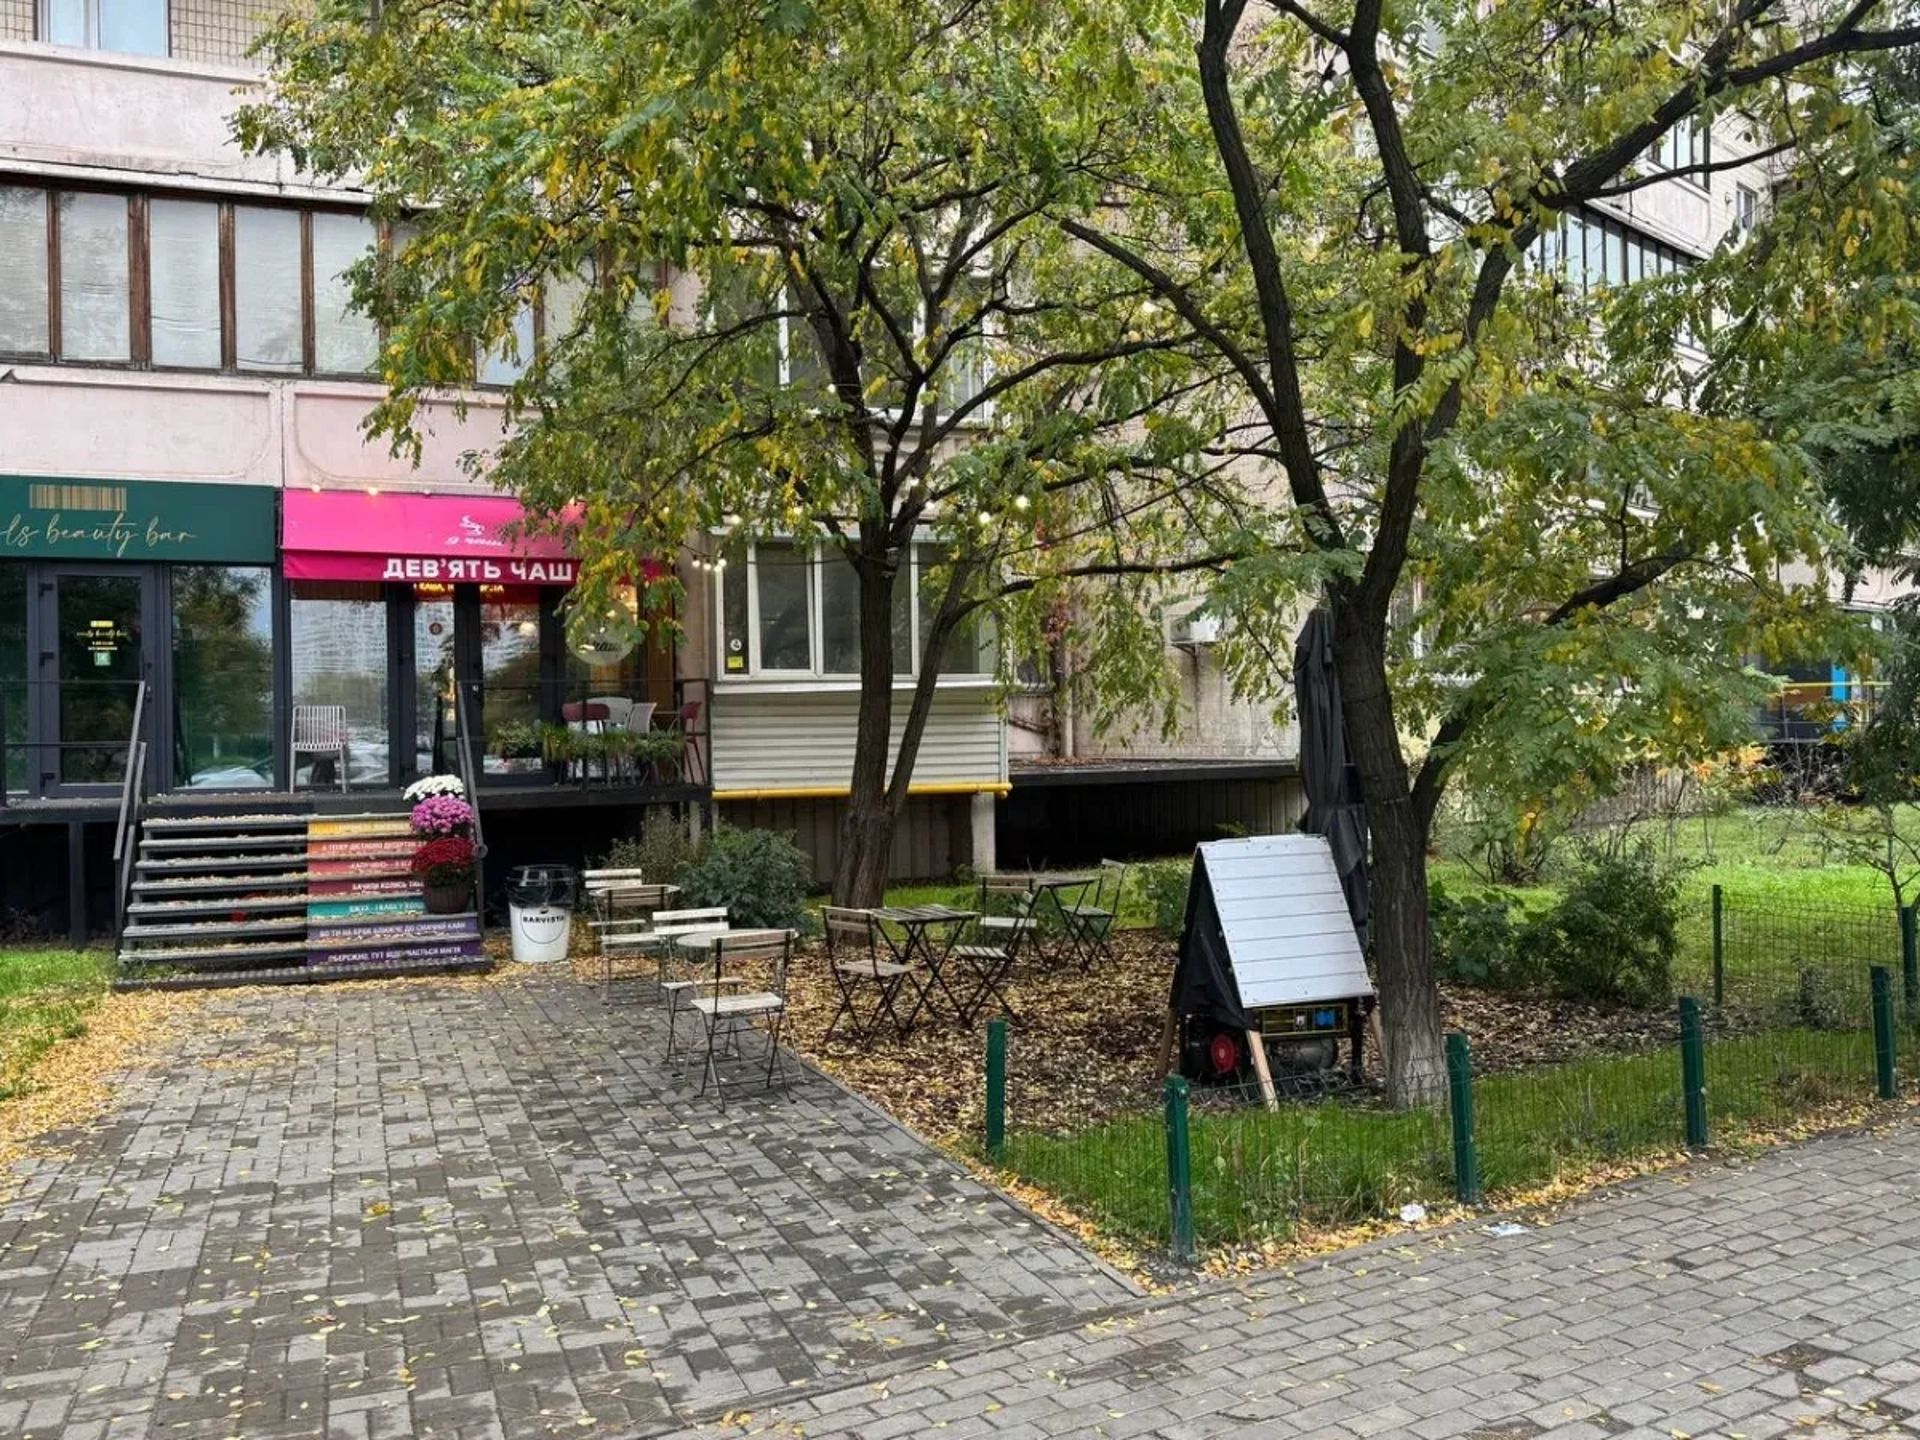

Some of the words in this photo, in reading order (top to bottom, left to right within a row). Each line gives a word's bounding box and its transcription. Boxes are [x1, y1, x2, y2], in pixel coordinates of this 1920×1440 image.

[46, 511, 139, 558] beauty
[145, 516, 198, 547] bar
[383, 557, 502, 580] ДЕВ'ЯТЬ
[511, 561, 572, 582] ЧАШ
[371, 951, 385, 959] ТУТ
